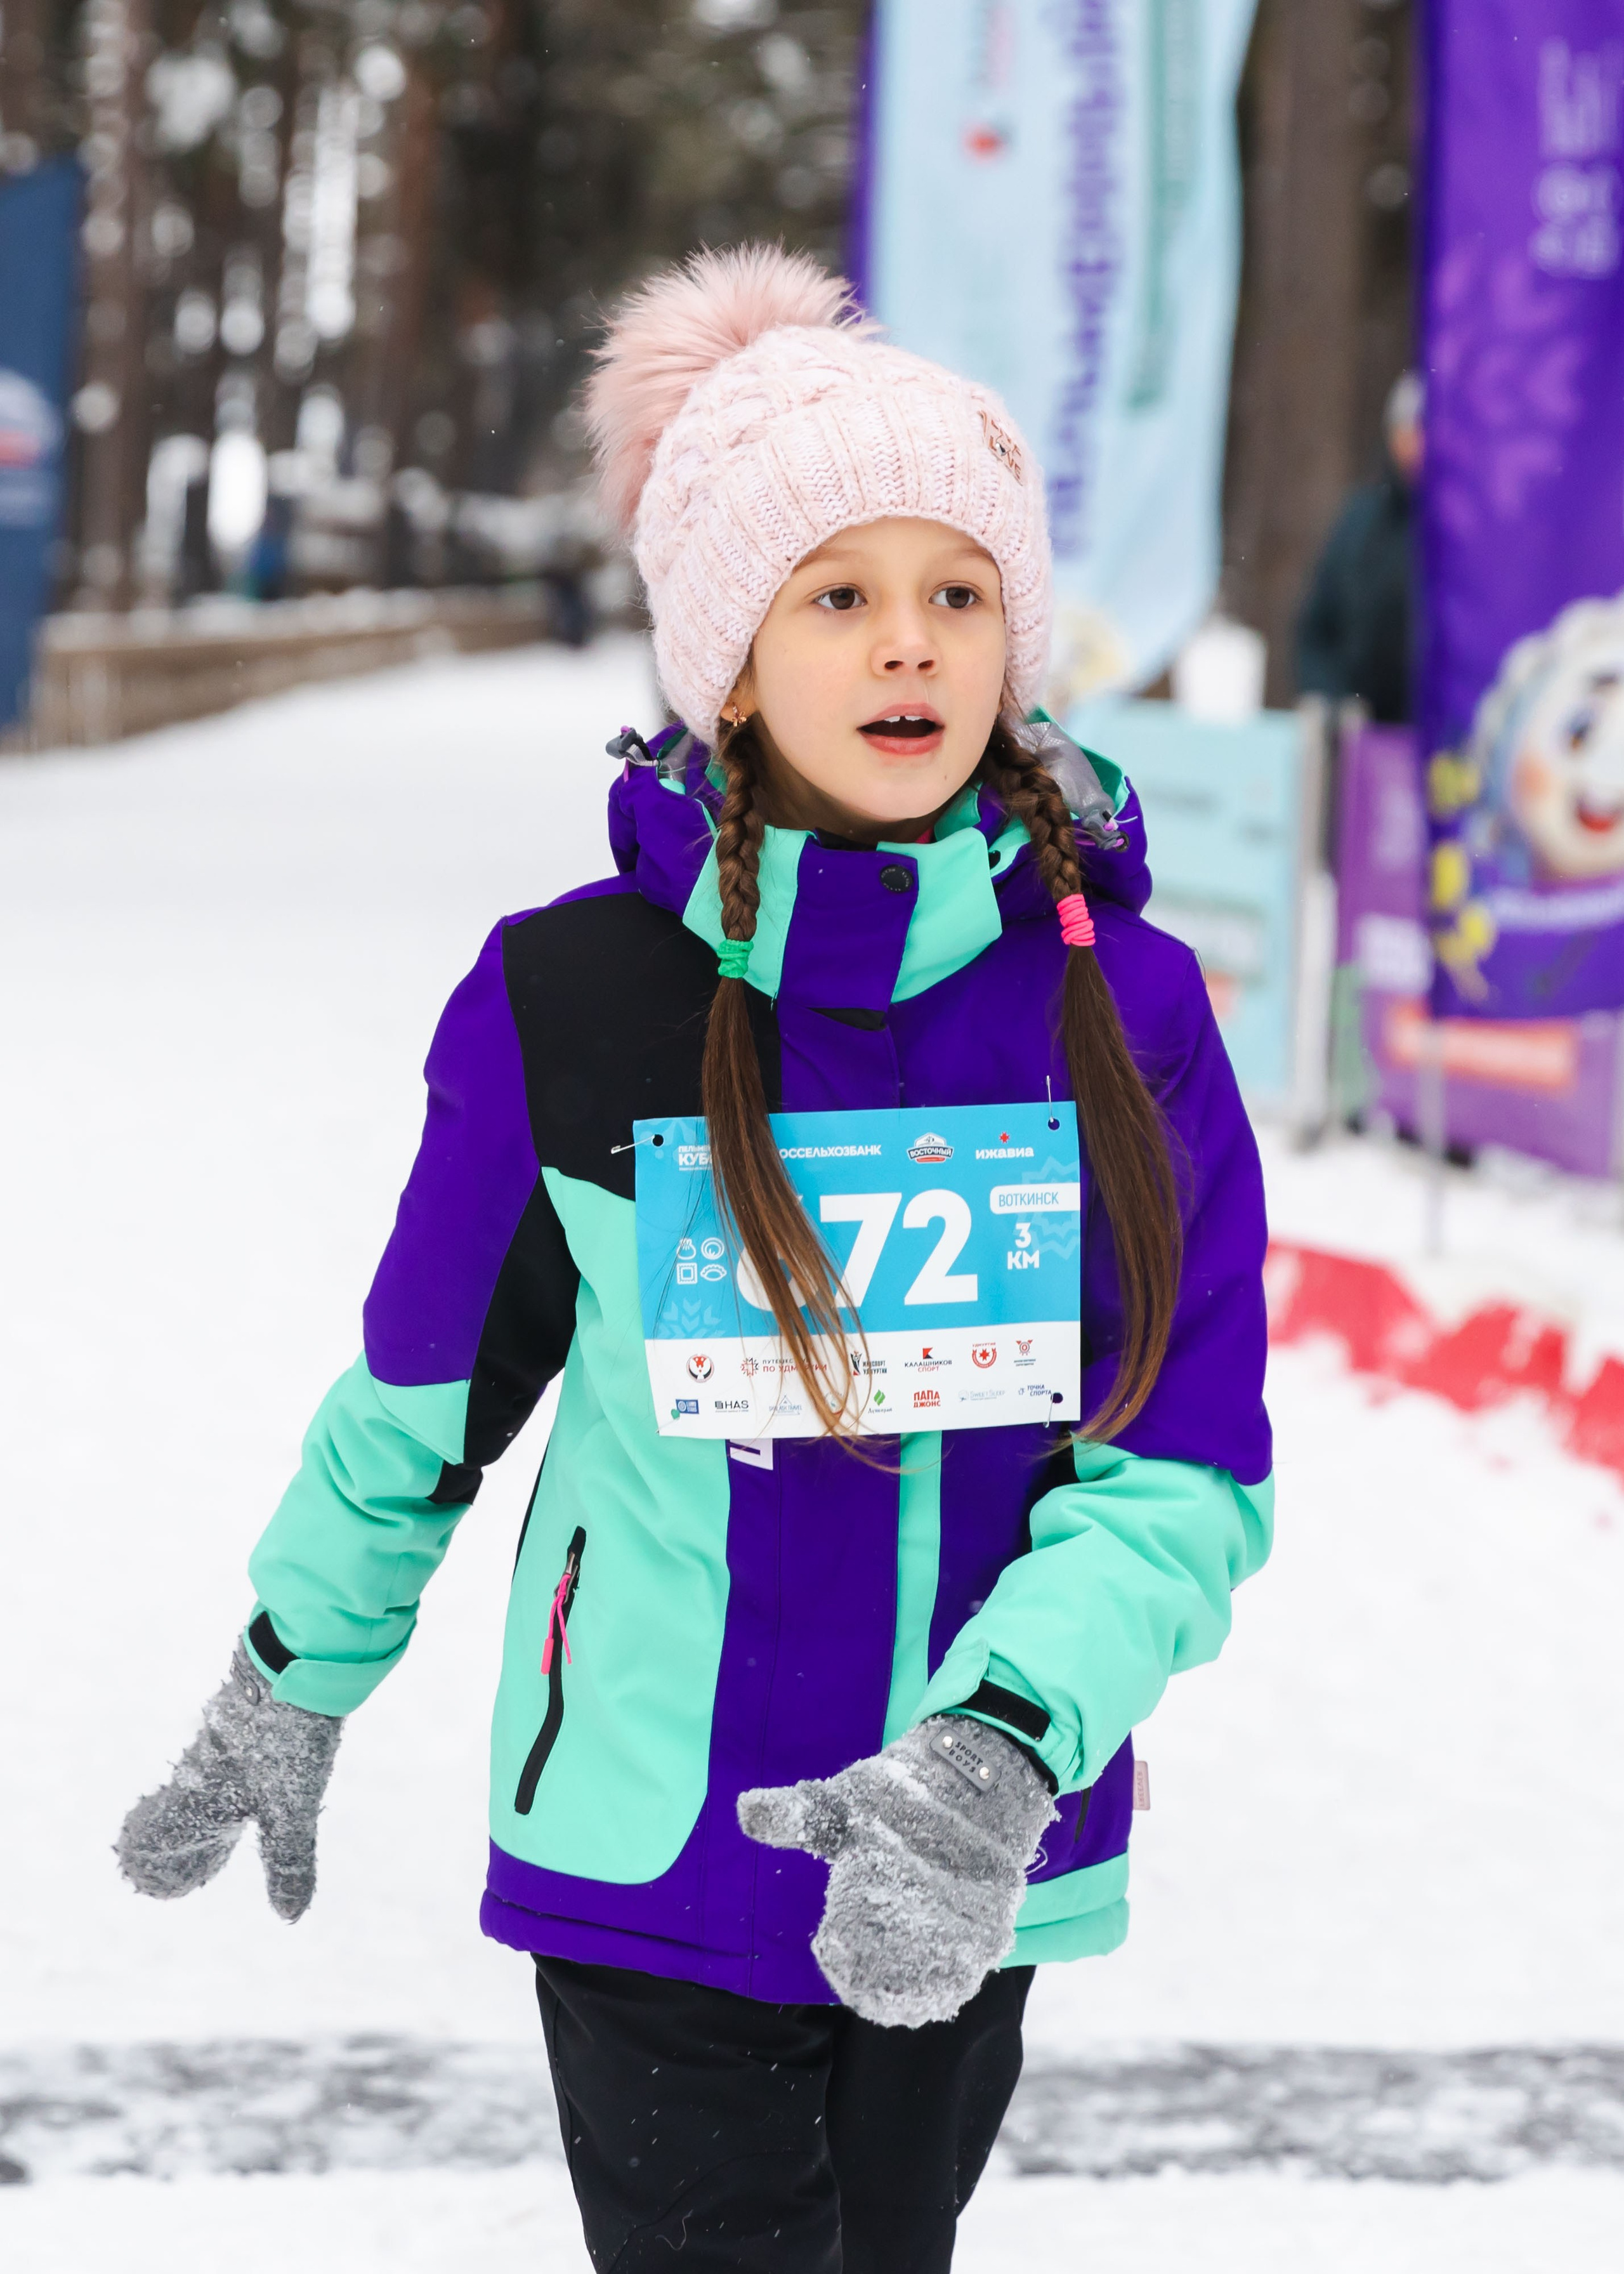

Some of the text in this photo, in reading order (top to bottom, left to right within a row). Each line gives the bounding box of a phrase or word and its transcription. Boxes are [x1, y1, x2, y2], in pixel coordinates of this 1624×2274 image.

[779, 1144, 882, 1159] ОССЕЛЬХОЗБАНК
[908, 1147, 952, 1158] ВОСТОЧНЫЙ
[678, 1153, 712, 1166] КУБ
[999, 1192, 1059, 1207] ВОТКИНСК
[1015, 1222, 1032, 1249] 3
[1007, 1250, 1040, 1270] КМ
[778, 1364, 827, 1373] УДМИИ
[904, 1360, 953, 1368] КАЛАШНИКОВ
[914, 1390, 940, 1401] ПАПА
[725, 1400, 749, 1409] HAS
[913, 1400, 941, 1409] ДЖОНС
[955, 1741, 984, 1766] SPORT
[948, 1749, 976, 1773] BOYS
